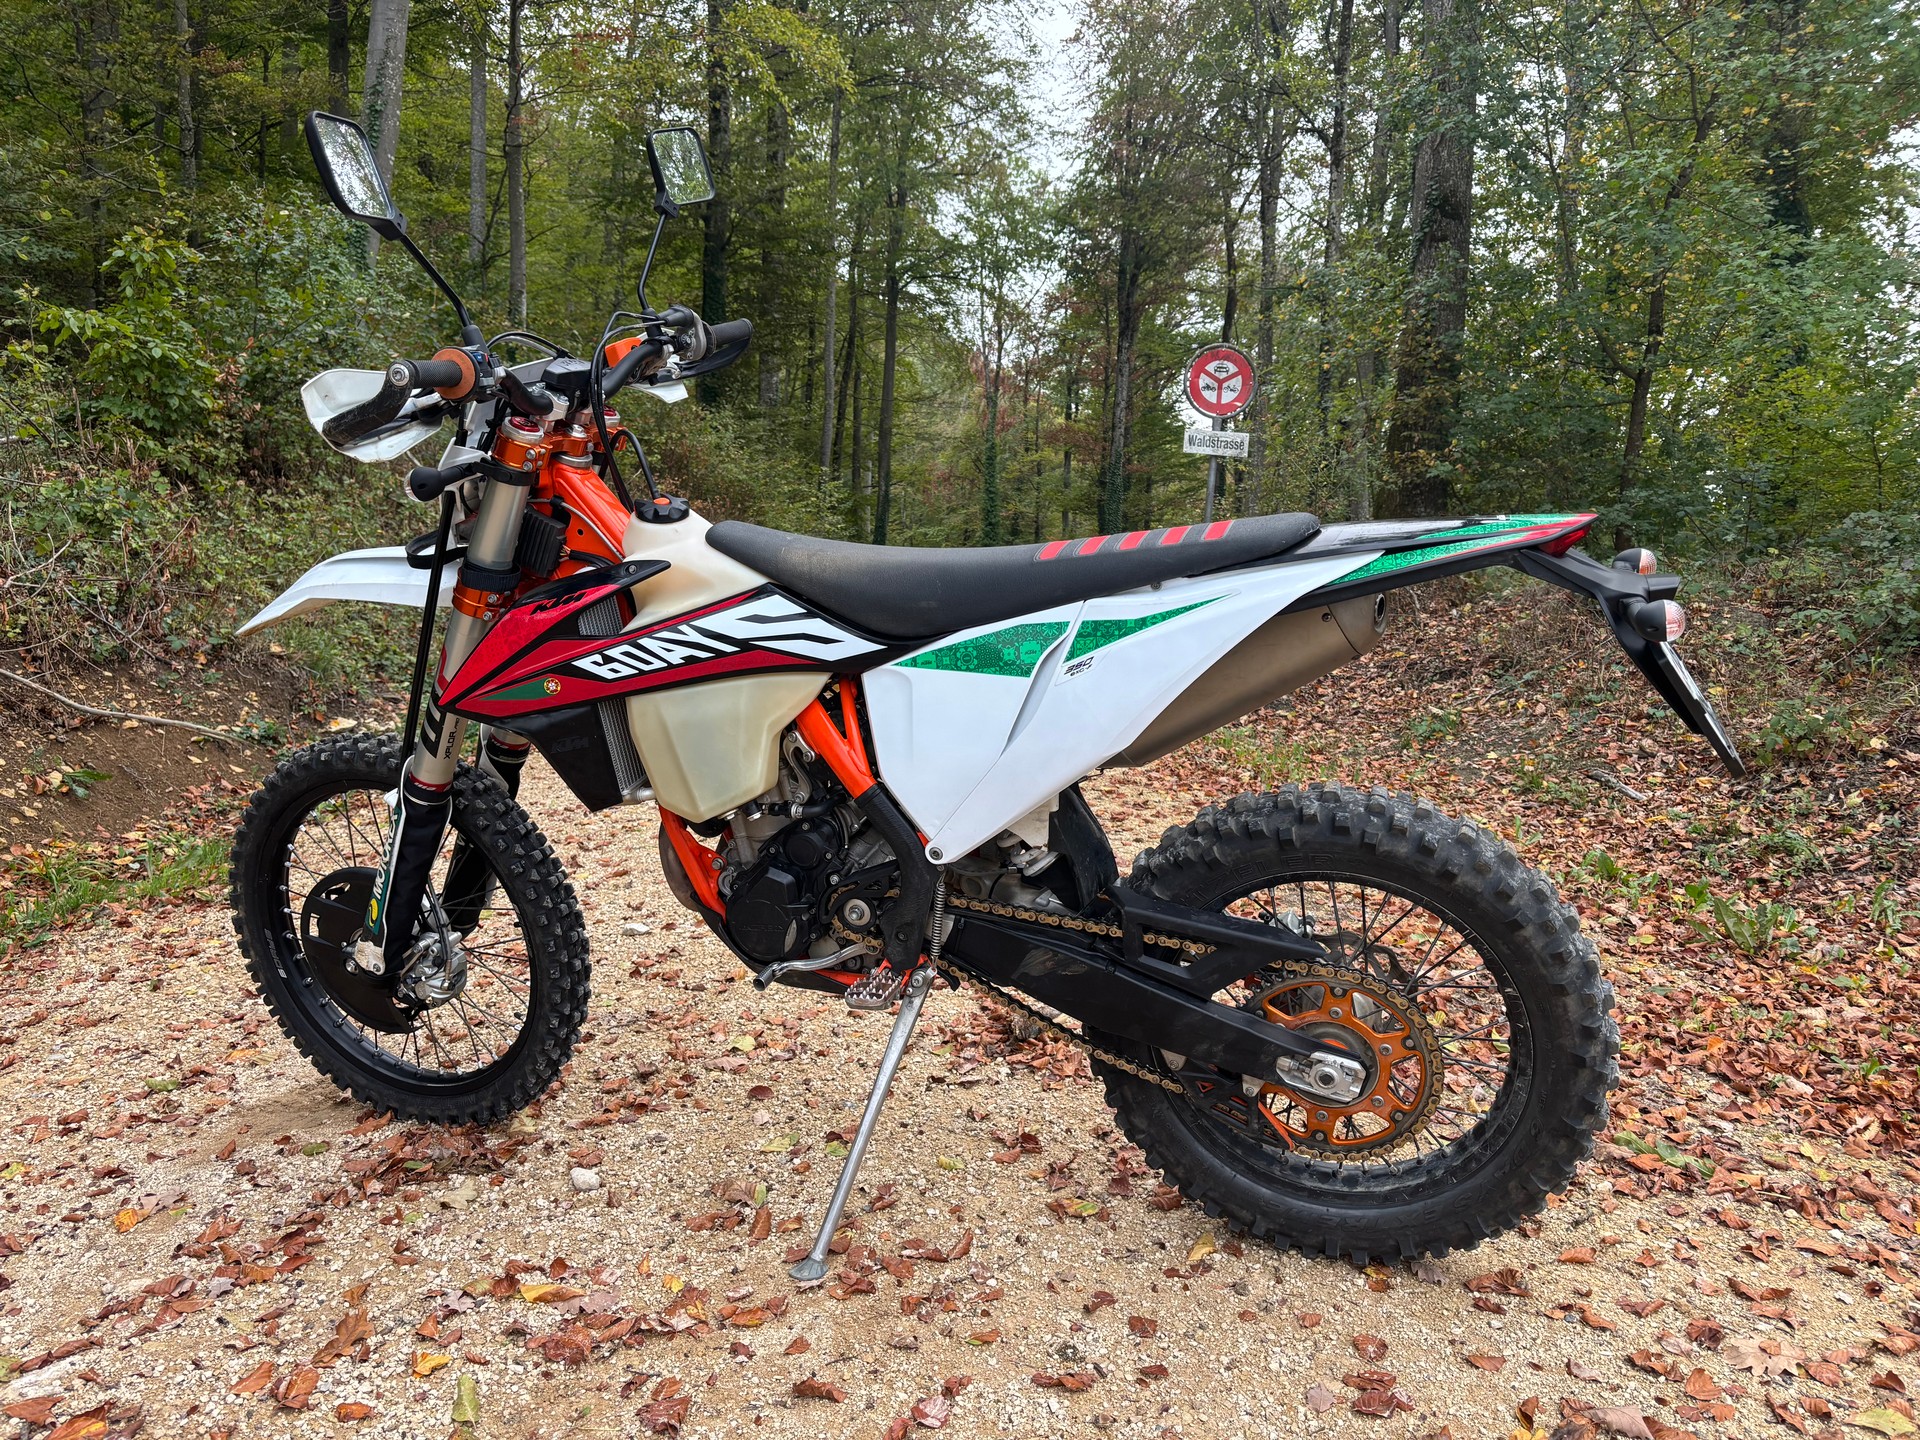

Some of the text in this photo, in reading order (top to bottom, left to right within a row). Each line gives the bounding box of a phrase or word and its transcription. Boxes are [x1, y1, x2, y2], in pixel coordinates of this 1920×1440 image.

[1188, 434, 1245, 450] Waldstrasse
[1064, 656, 1095, 675] 350
[443, 731, 456, 760] XPLOR
[550, 735, 590, 755] KTM
